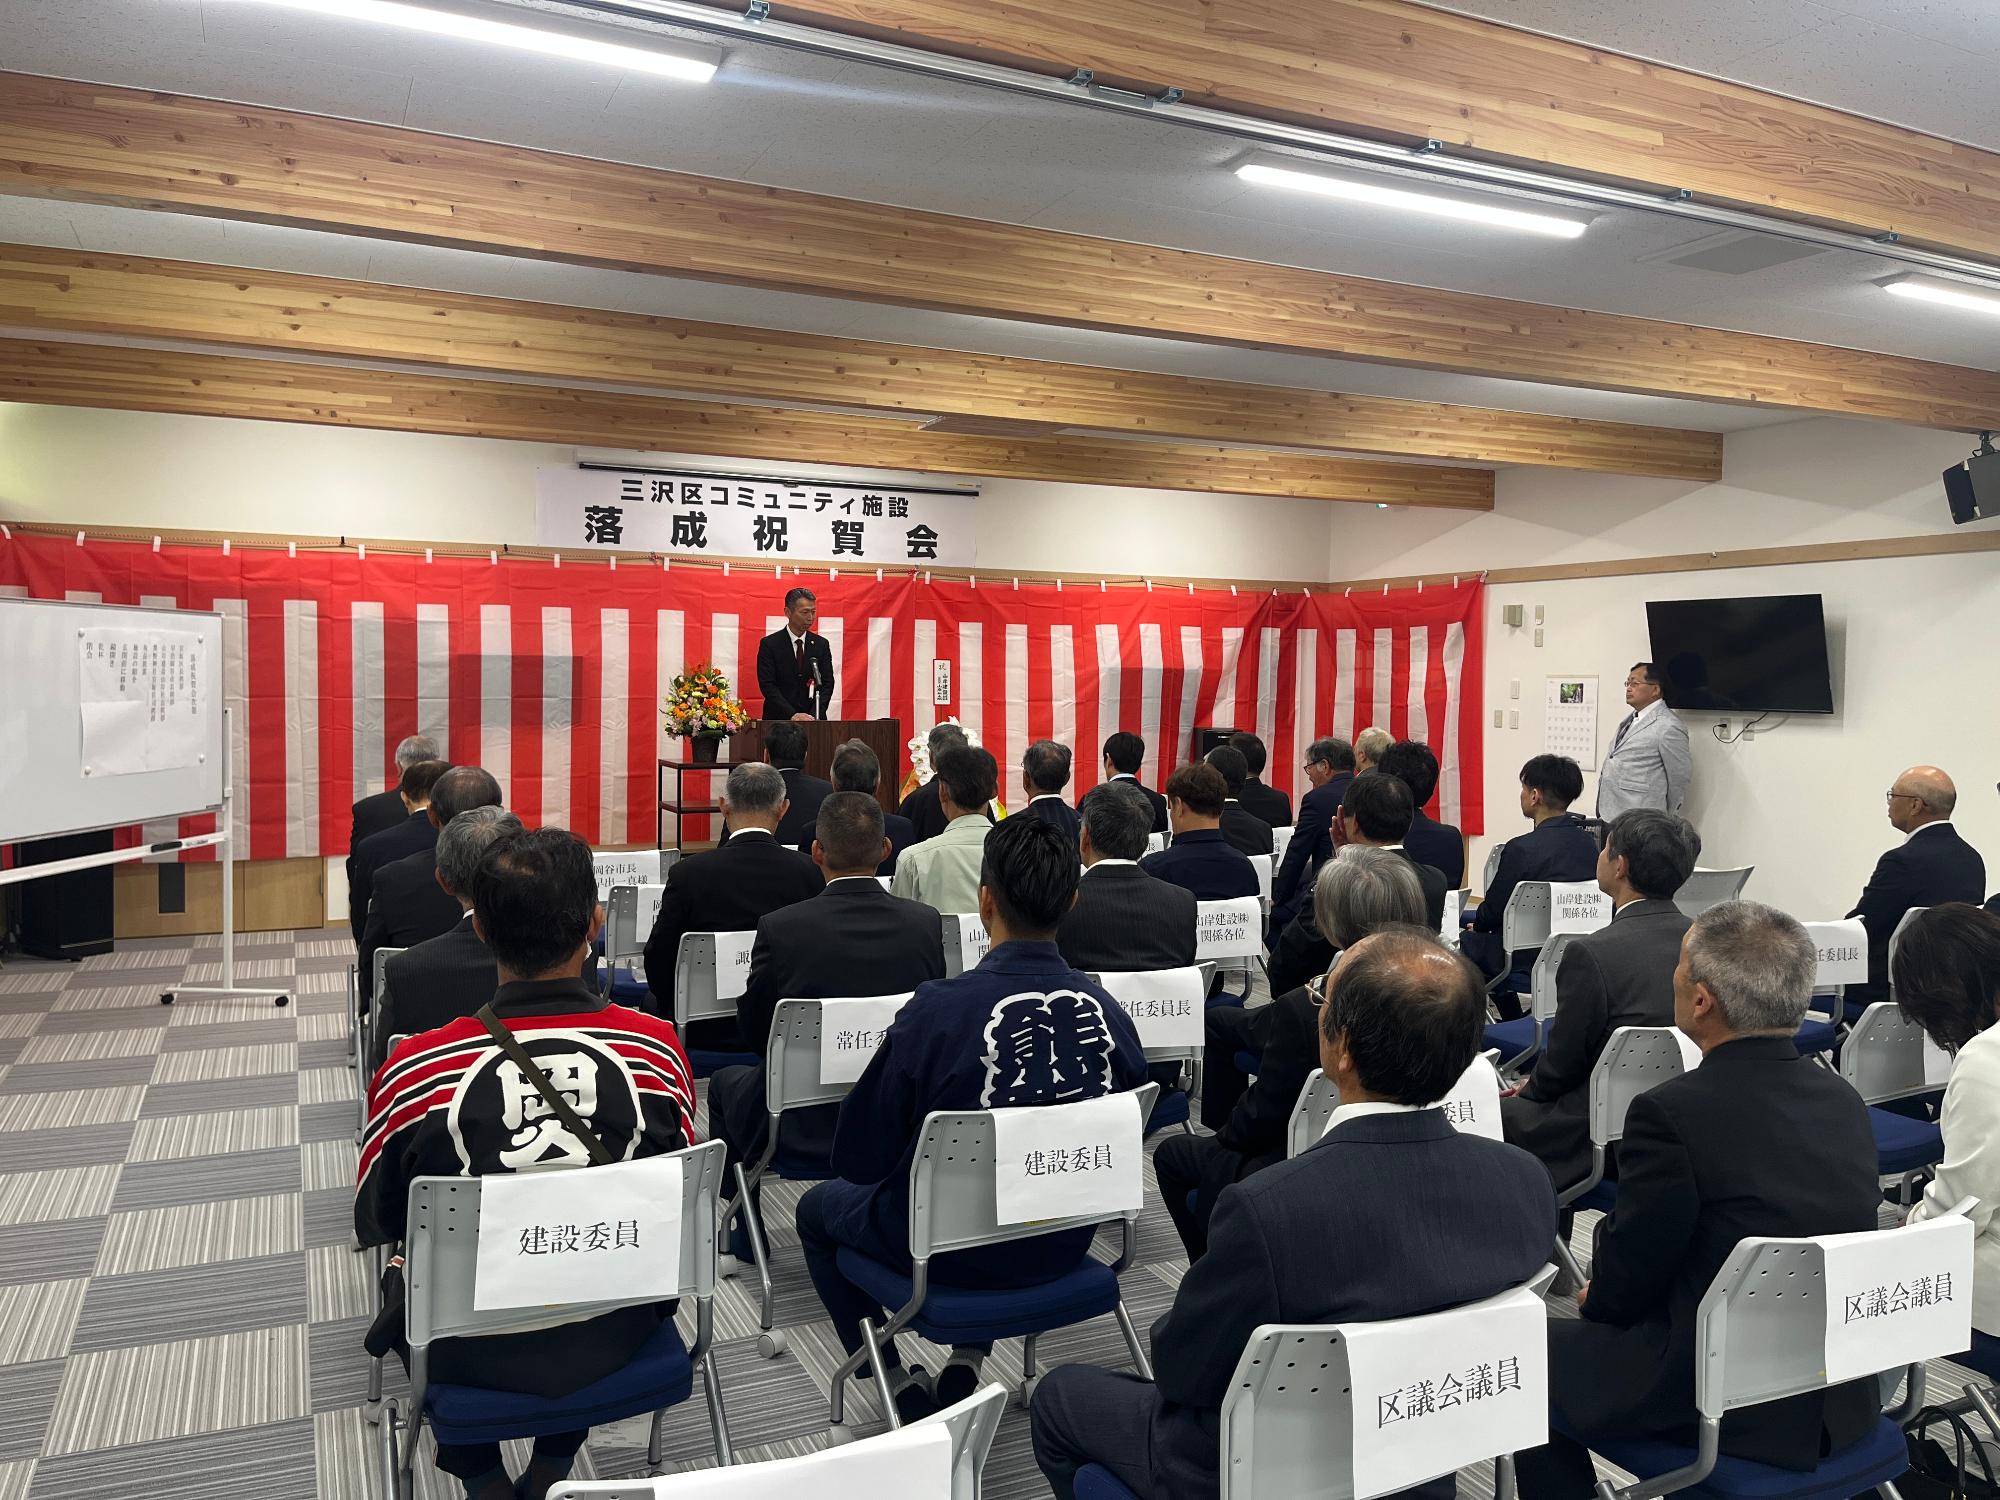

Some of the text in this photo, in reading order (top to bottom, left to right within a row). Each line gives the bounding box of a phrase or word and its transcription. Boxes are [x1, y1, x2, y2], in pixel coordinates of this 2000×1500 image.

[620, 479, 909, 519] 三沢区コミュニティ施設
[584, 505, 939, 559] 落成祝賀会
[1562, 907, 1599, 919] 関係各位
[1201, 928, 1246, 942] 関係各位
[1024, 1143, 1113, 1177] 建設委員
[518, 1219, 641, 1257] 建設委員
[1844, 1271, 1953, 1325] 区議会議員
[1376, 1355, 1522, 1430] 区議会議員
